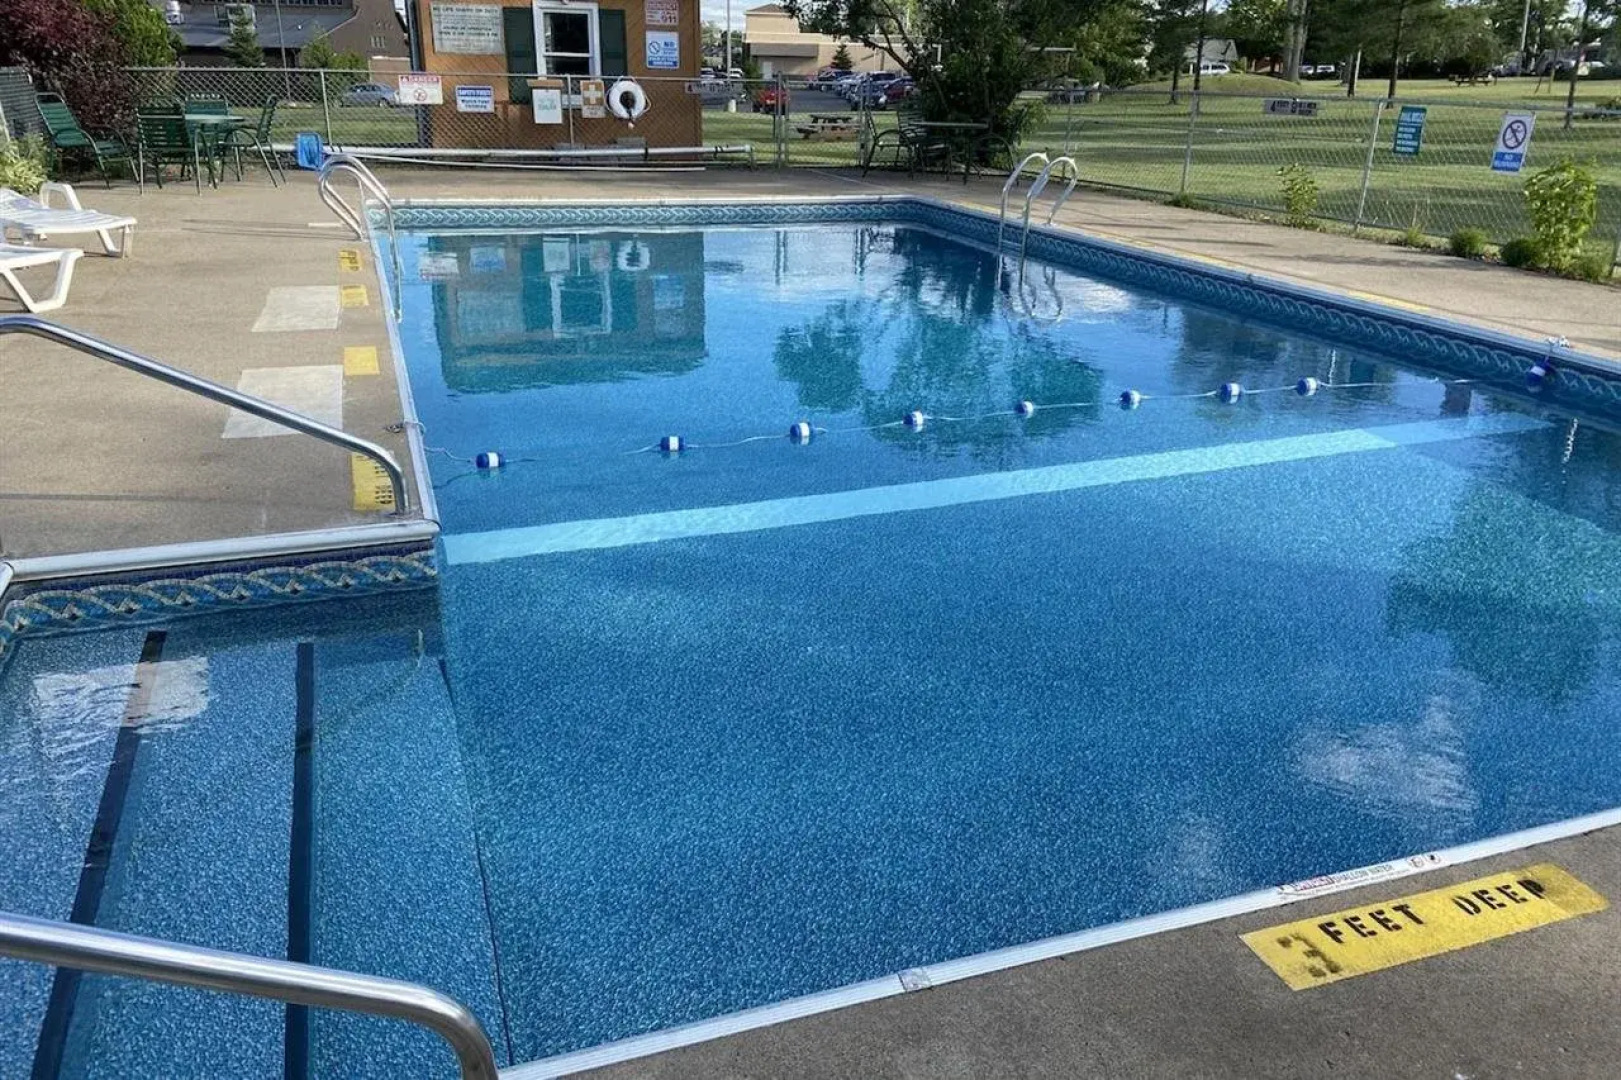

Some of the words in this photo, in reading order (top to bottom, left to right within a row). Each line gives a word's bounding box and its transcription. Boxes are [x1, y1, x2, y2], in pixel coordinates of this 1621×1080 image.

[1276, 931, 1341, 978] 3
[1317, 903, 1426, 944] FEET
[1450, 878, 1548, 916] DEEP
